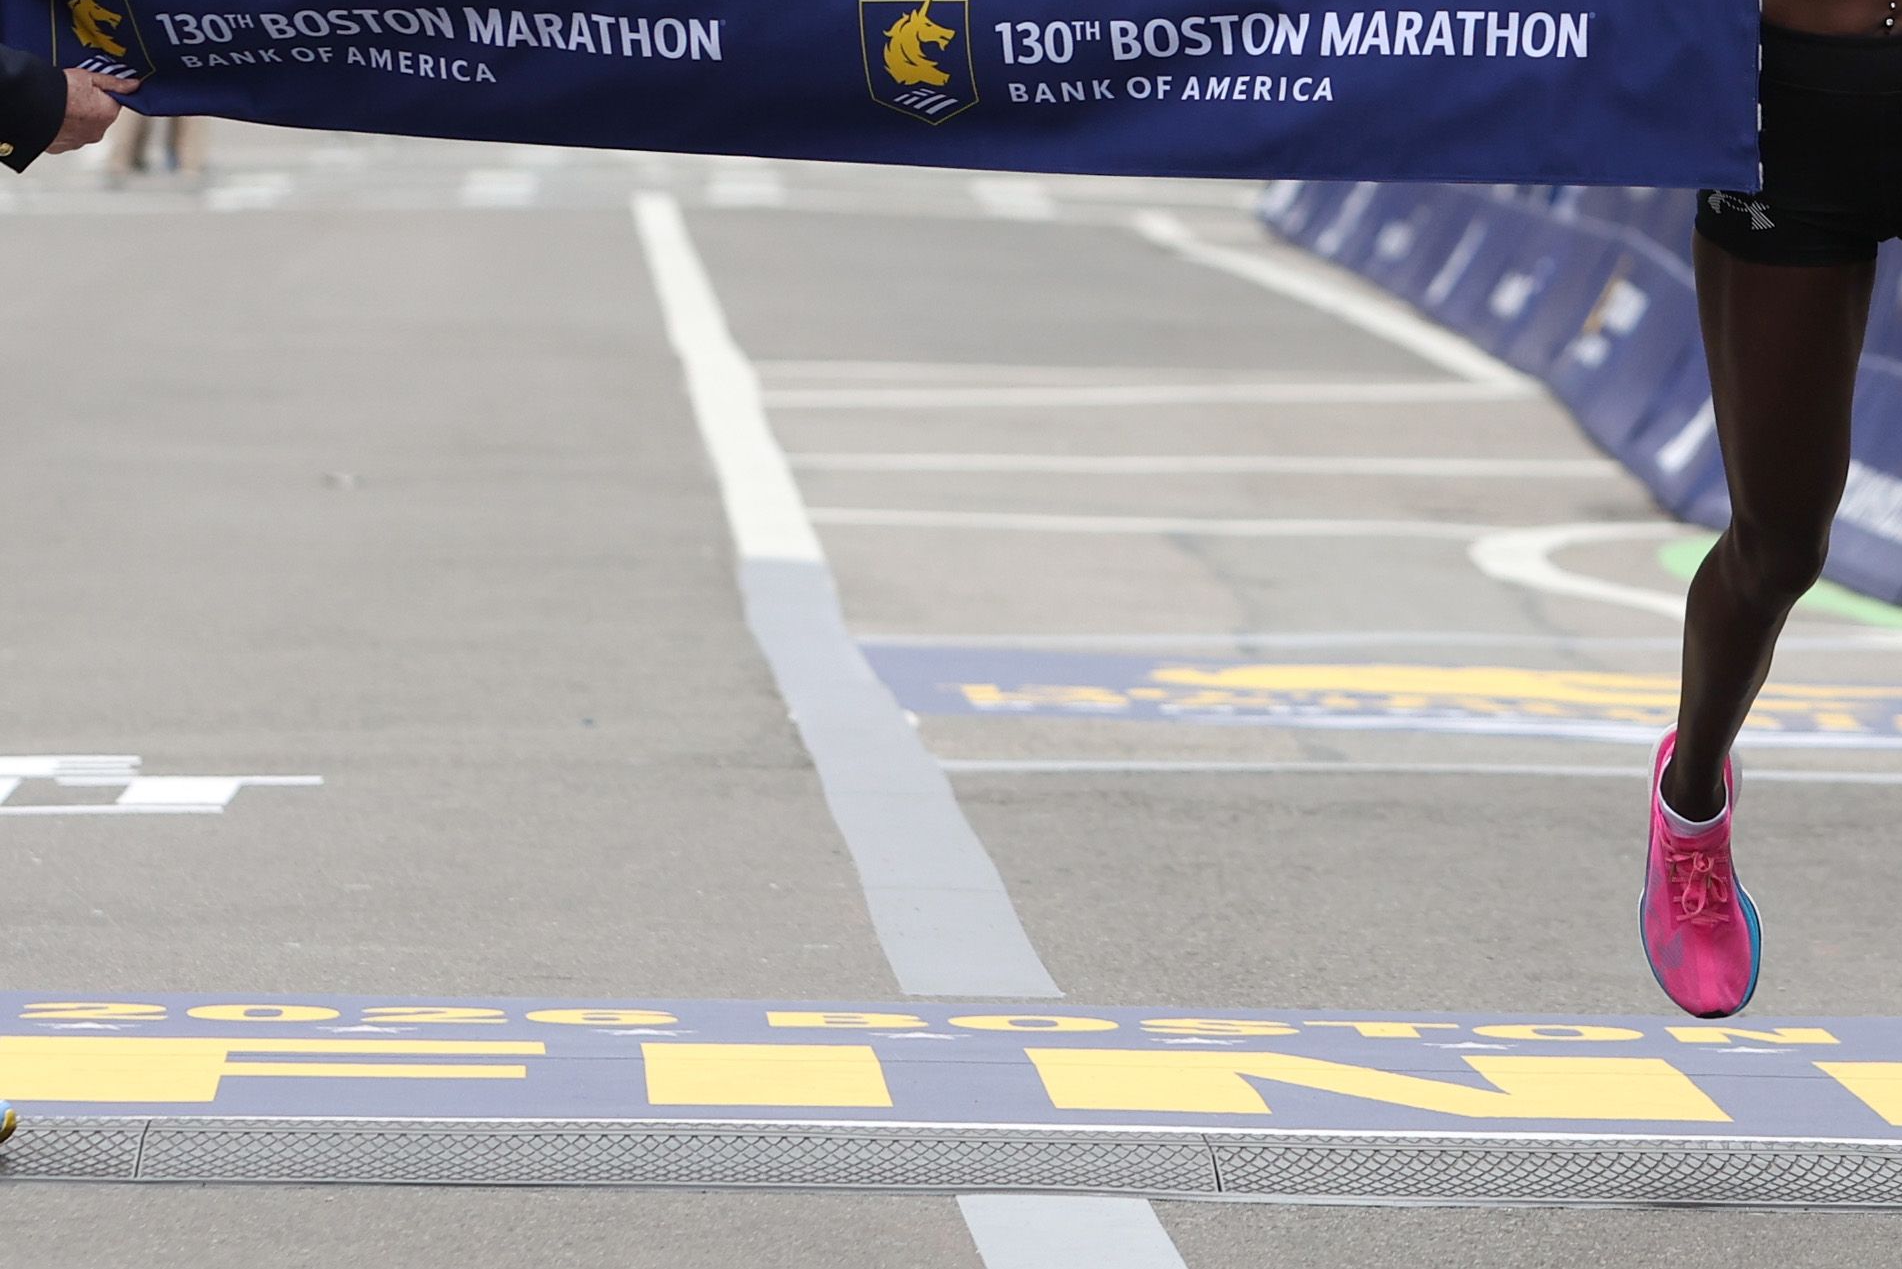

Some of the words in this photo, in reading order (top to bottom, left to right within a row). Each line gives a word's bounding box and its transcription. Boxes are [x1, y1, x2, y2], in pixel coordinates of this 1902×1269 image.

[155, 13, 255, 46] 130TH
[259, 7, 454, 40] BOSTON
[462, 5, 723, 62] MARATHON
[994, 20, 1101, 65] 130TH
[1109, 12, 1311, 61] BOSTON
[1319, 9, 1590, 59] MARATHON
[181, 48, 283, 69] BANK
[290, 46, 334, 64] OF
[346, 46, 498, 84] AMERICA
[1008, 78, 1115, 104] BANK
[1126, 75, 1173, 100] OF
[1180, 74, 1336, 103] AMERICA
[18, 1002, 680, 1025] 2026
[765, 1011, 1841, 1045] BOSTON
